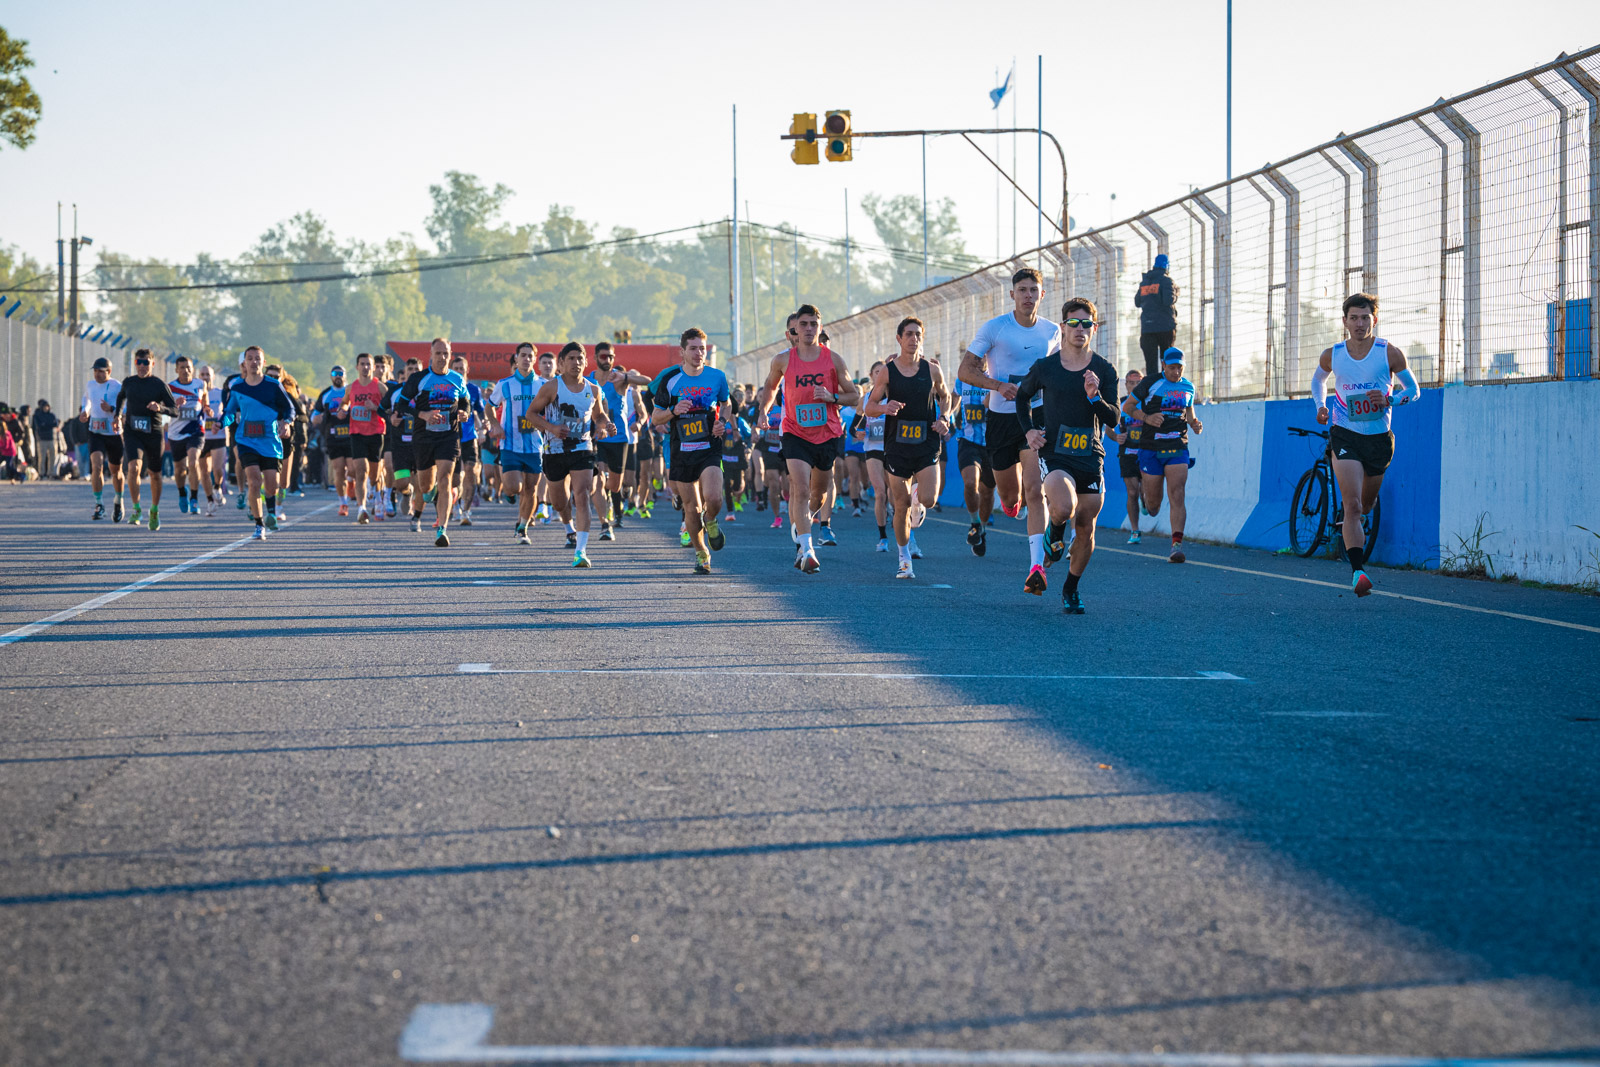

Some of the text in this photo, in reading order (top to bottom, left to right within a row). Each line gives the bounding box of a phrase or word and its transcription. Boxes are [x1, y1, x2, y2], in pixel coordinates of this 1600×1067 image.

[796, 373, 824, 388] KRC
[1342, 382, 1380, 391] RUNNEA
[801, 408, 822, 422] 313
[966, 409, 982, 420] 716
[134, 420, 148, 430] 167
[521, 419, 535, 430] 70
[682, 420, 704, 436] 707
[902, 425, 921, 438] 718
[1130, 430, 1142, 440] 63
[1063, 433, 1088, 449] 706
